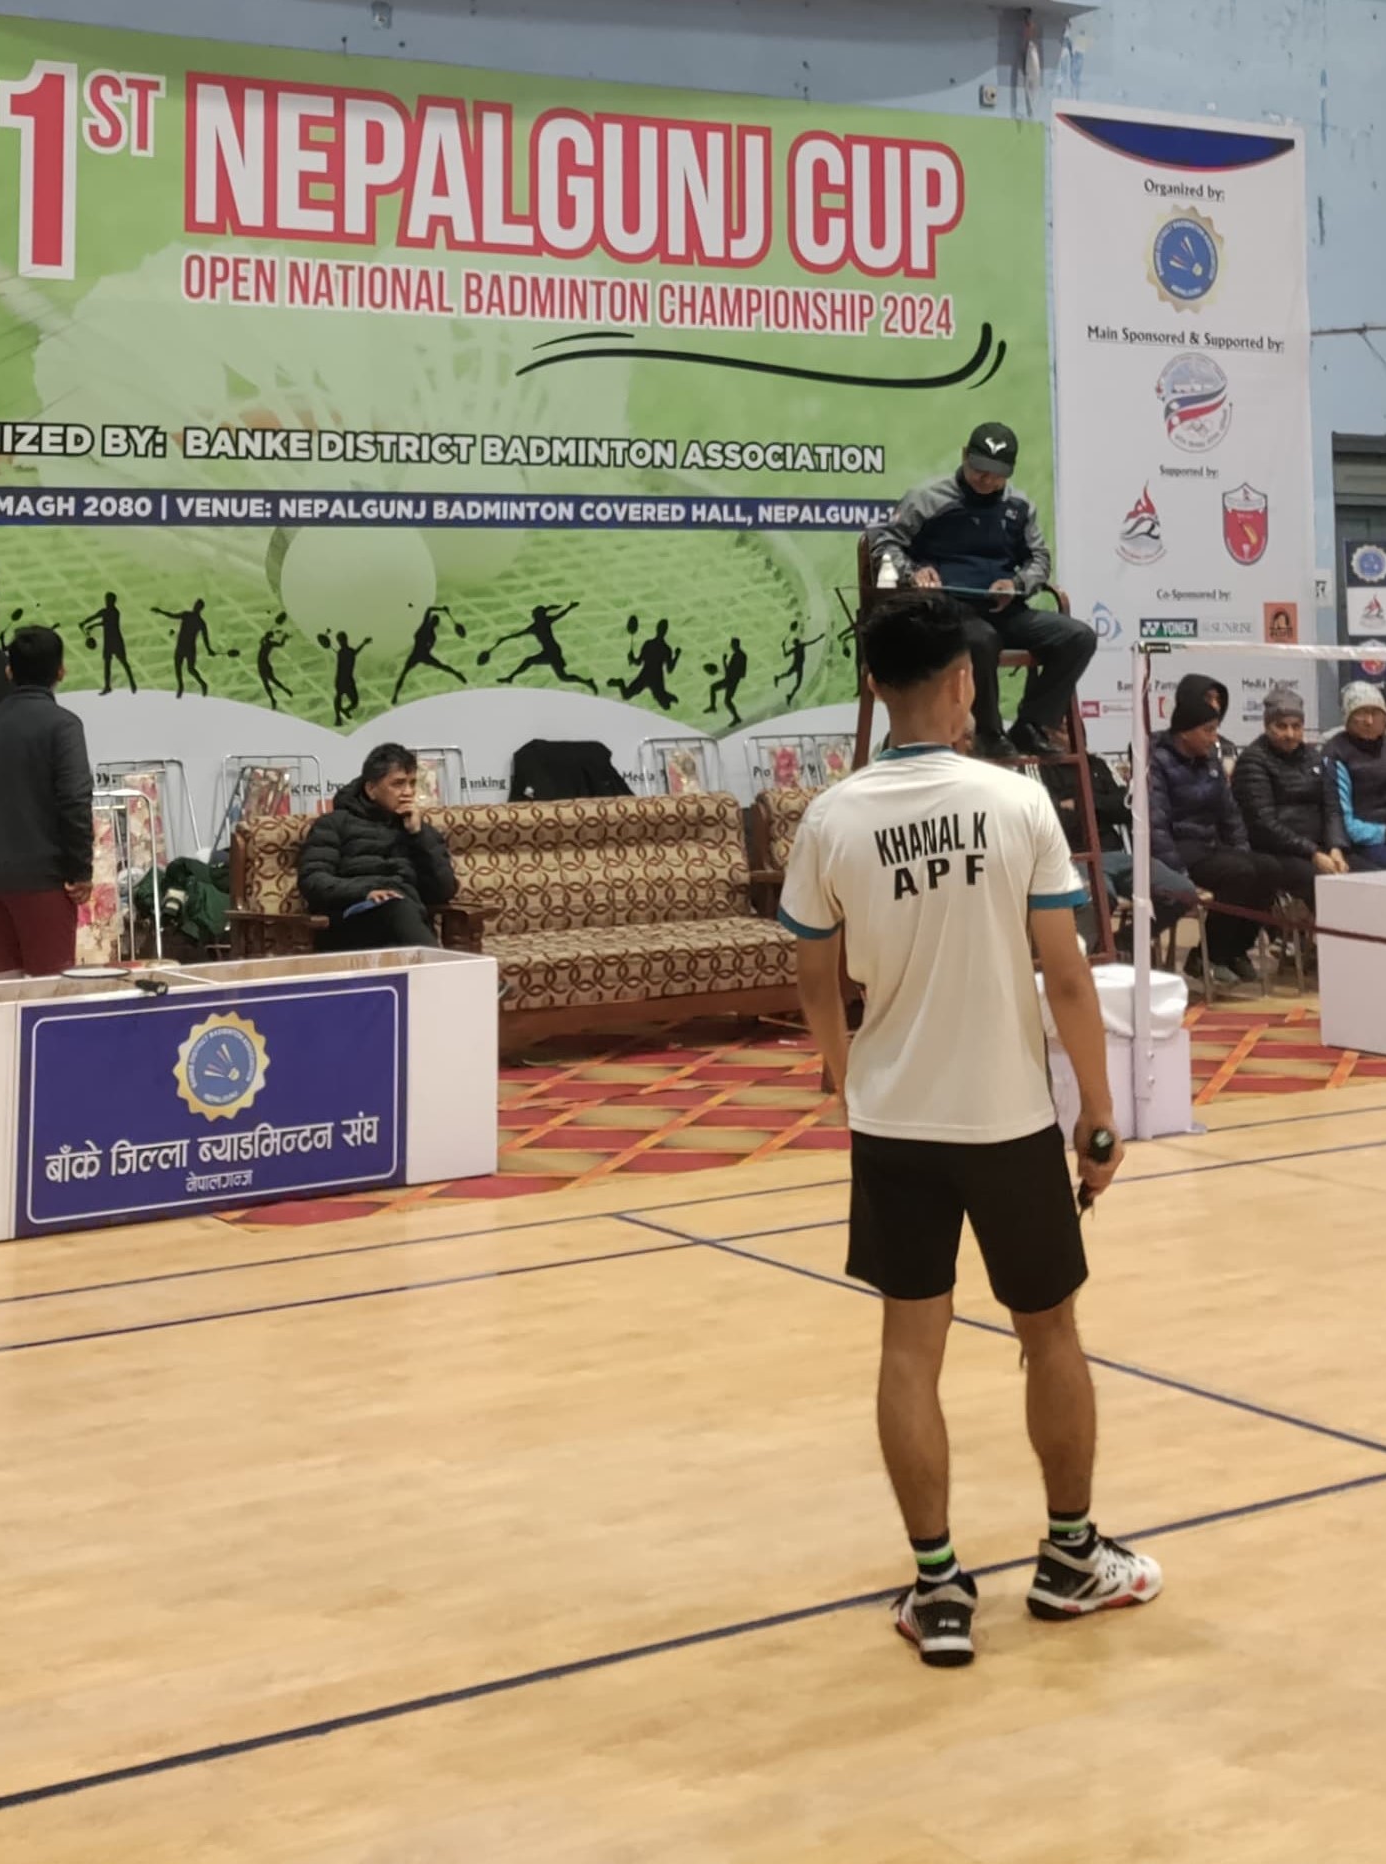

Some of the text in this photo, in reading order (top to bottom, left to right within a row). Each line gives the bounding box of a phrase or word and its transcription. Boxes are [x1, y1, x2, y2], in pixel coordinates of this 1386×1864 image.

[185, 72, 771, 269] NEPALGUNJ
[786, 130, 963, 278] CUP
[1144, 179, 1225, 201] Organized by:
[183, 254, 955, 338] OPEN NATIONAL BADMINTON CHAMPIONSHIP 2024
[1087, 326, 1285, 352] Main Sponsored & Supported by:
[101, 425, 167, 458] BY:
[183, 428, 312, 461] BANKE
[318, 432, 476, 464] DISTRICT
[481, 435, 677, 468] BADMINTON
[681, 440, 885, 473] ASSOCIATION
[1160, 464, 1204, 478] Supported
[83, 496, 153, 519] 2080
[175, 497, 272, 520] VENUE:
[279, 498, 427, 521] NEPALGUNJ
[432, 498, 575, 522] BADMINTON
[579, 500, 686, 524] COVERED
[691, 502, 753, 527] HALL,
[1156, 588, 1217, 602] Co-Sponsored
[1162, 621, 1195, 636] YONEX
[874, 812, 988, 867] KHANAL K
[45, 1111, 380, 1183] बाँके जिल्ला ब्याडमिन्टन संघ
